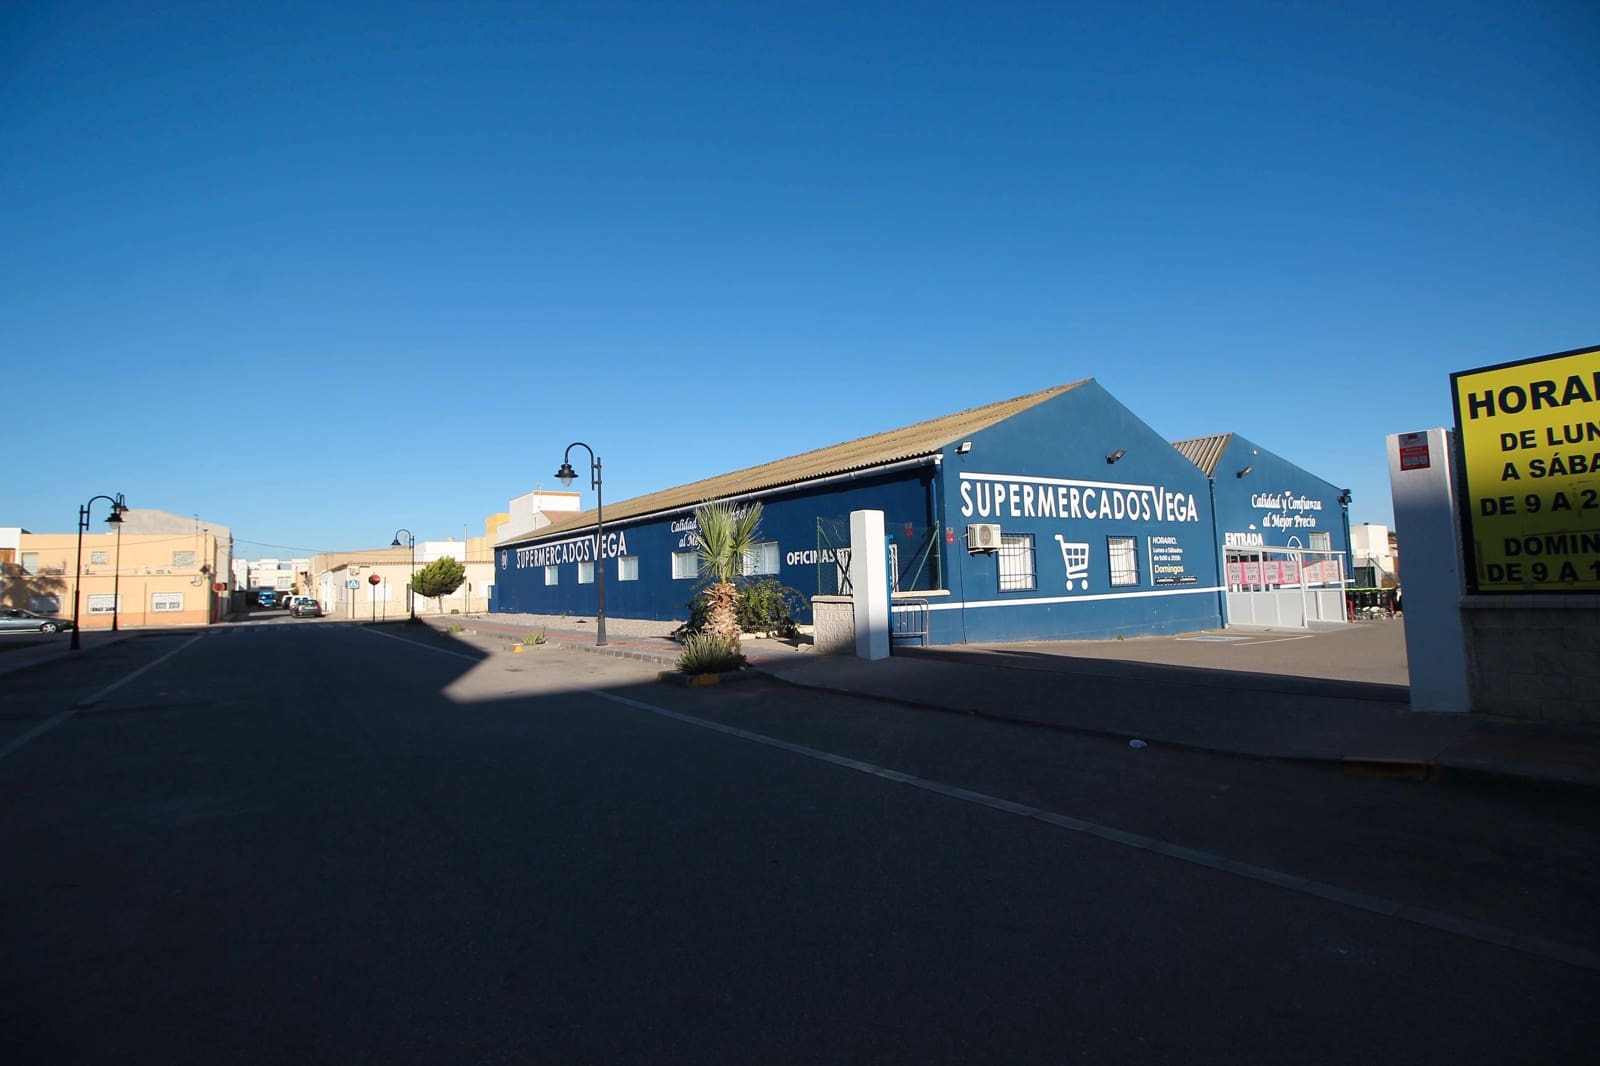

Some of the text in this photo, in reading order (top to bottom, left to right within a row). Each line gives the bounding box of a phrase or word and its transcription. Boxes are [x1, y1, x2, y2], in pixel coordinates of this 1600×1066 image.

[1500, 422, 1600, 452] DE LUN
[1502, 462, 1521, 481] A
[960, 480, 1200, 523] SUPERMERCADOS VEGA
[1252, 492, 1322, 514] Calidad y Confianza
[1480, 489, 1599, 516] DE 9 A 2
[671, 517, 697, 532] Calidad
[1263, 513, 1316, 532] al Mejor Precio
[516, 538, 590, 569] SUPERMERCADOS
[591, 530, 628, 561] VEGA
[1225, 532, 1264, 546] ENTRADA
[1504, 533, 1600, 556] DOMIN
[786, 548, 835, 566] OFICINAS
[1154, 564, 1184, 575] Domingos
[1487, 563, 1523, 582] DE
[1532, 562, 1548, 581] 9
[1559, 561, 1579, 582] A
